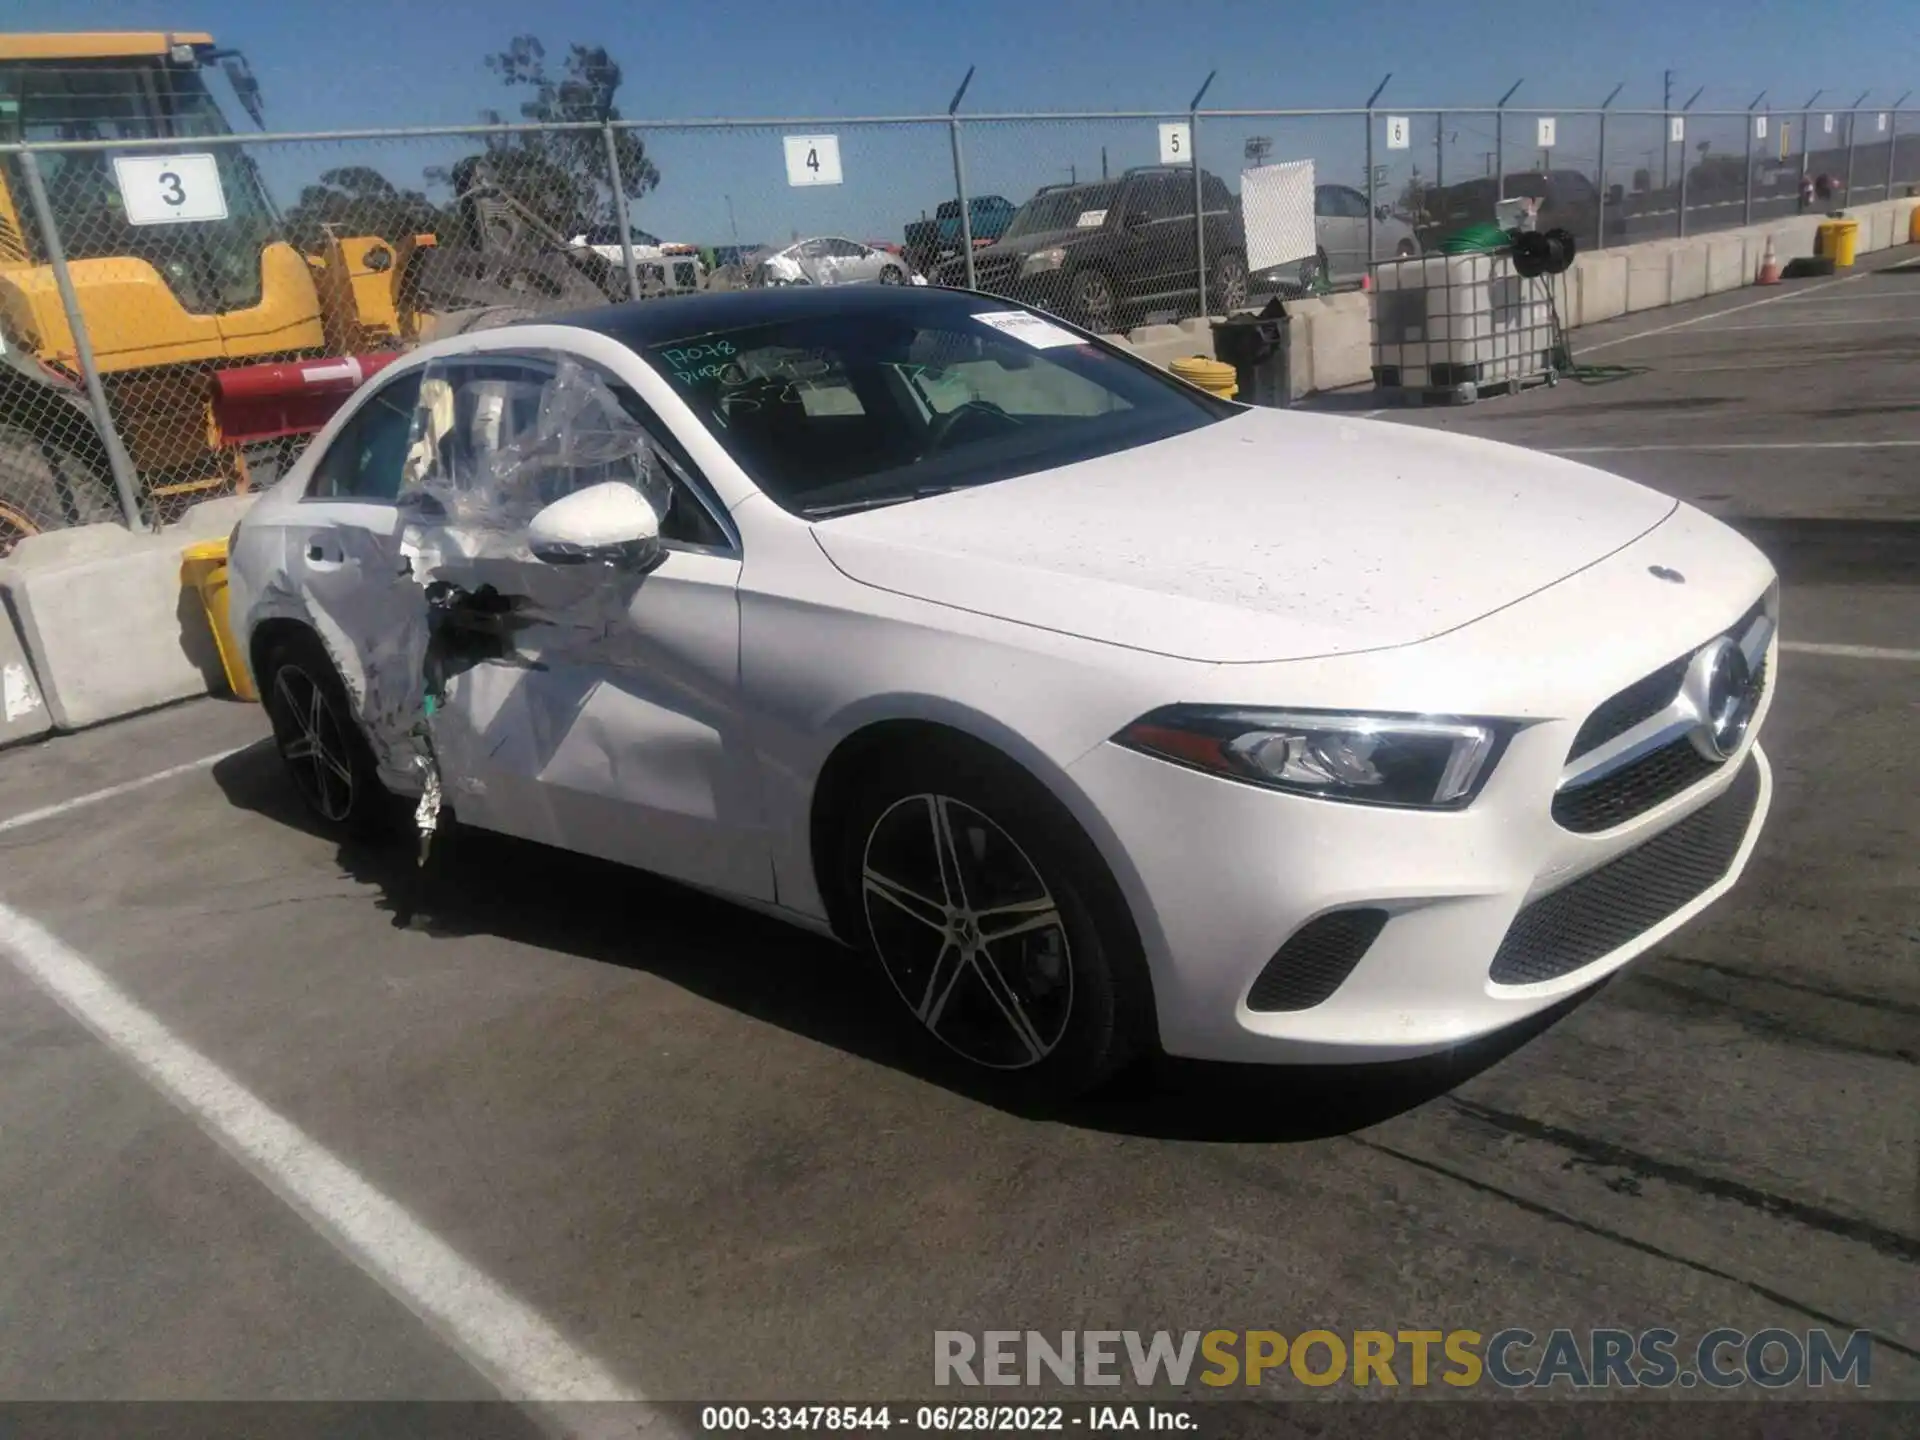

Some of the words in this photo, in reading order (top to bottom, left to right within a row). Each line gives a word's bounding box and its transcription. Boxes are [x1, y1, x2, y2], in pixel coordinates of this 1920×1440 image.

[1171, 133, 1180, 153] 5
[806, 148, 820, 172] 4
[159, 172, 186, 206] 3
[661, 339, 736, 369] 17078
